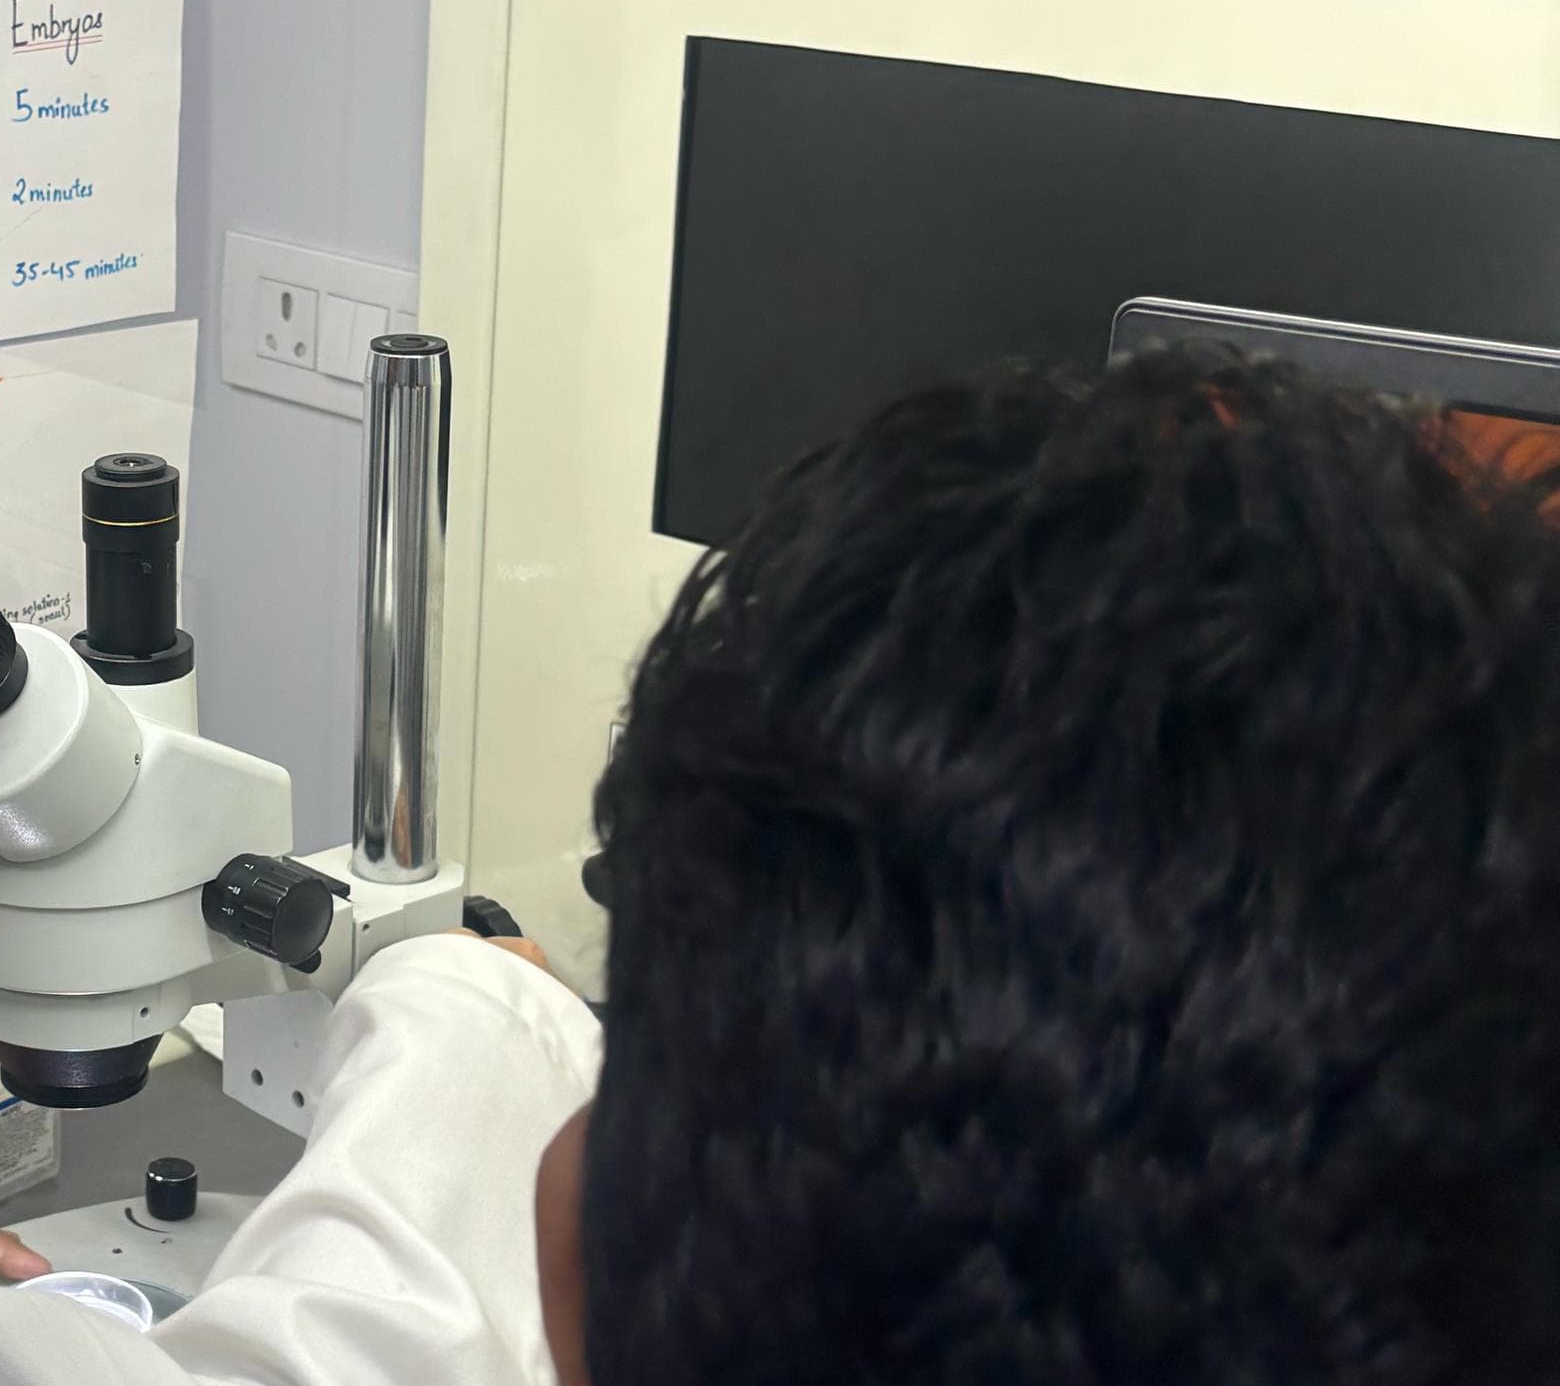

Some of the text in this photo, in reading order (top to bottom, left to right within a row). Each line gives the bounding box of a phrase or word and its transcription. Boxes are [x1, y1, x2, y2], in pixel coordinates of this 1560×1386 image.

[11, 88, 109, 122] 5 minutes
[12, 177, 94, 205] 2 minutes
[11, 253, 138, 287] 35-45 minutes
